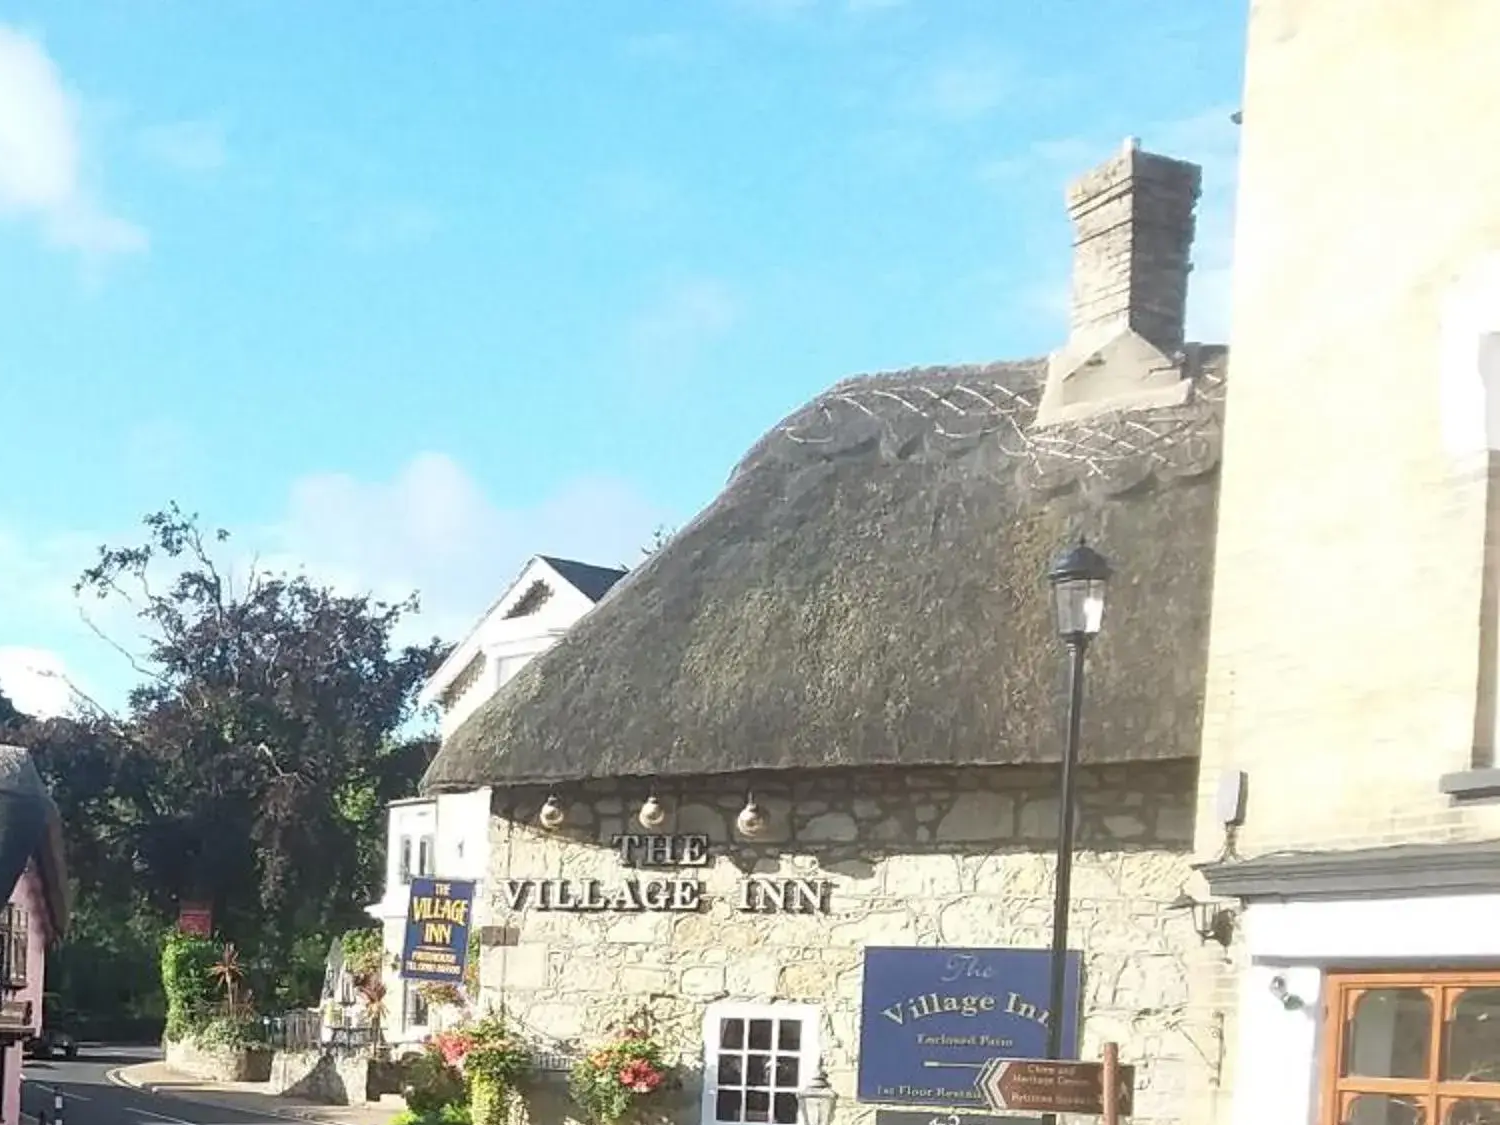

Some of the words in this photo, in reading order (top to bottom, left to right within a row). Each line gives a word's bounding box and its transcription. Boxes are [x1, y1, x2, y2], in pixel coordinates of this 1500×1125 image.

[613, 834, 709, 866] THE
[435, 883, 451, 896] THE
[498, 877, 702, 910] VILLAGE
[737, 877, 832, 911] INN
[412, 896, 469, 926] VILLAGE
[424, 923, 452, 944] INN
[941, 954, 996, 982] The
[880, 991, 996, 1026] Village
[899, 1086, 934, 1097] Floor
